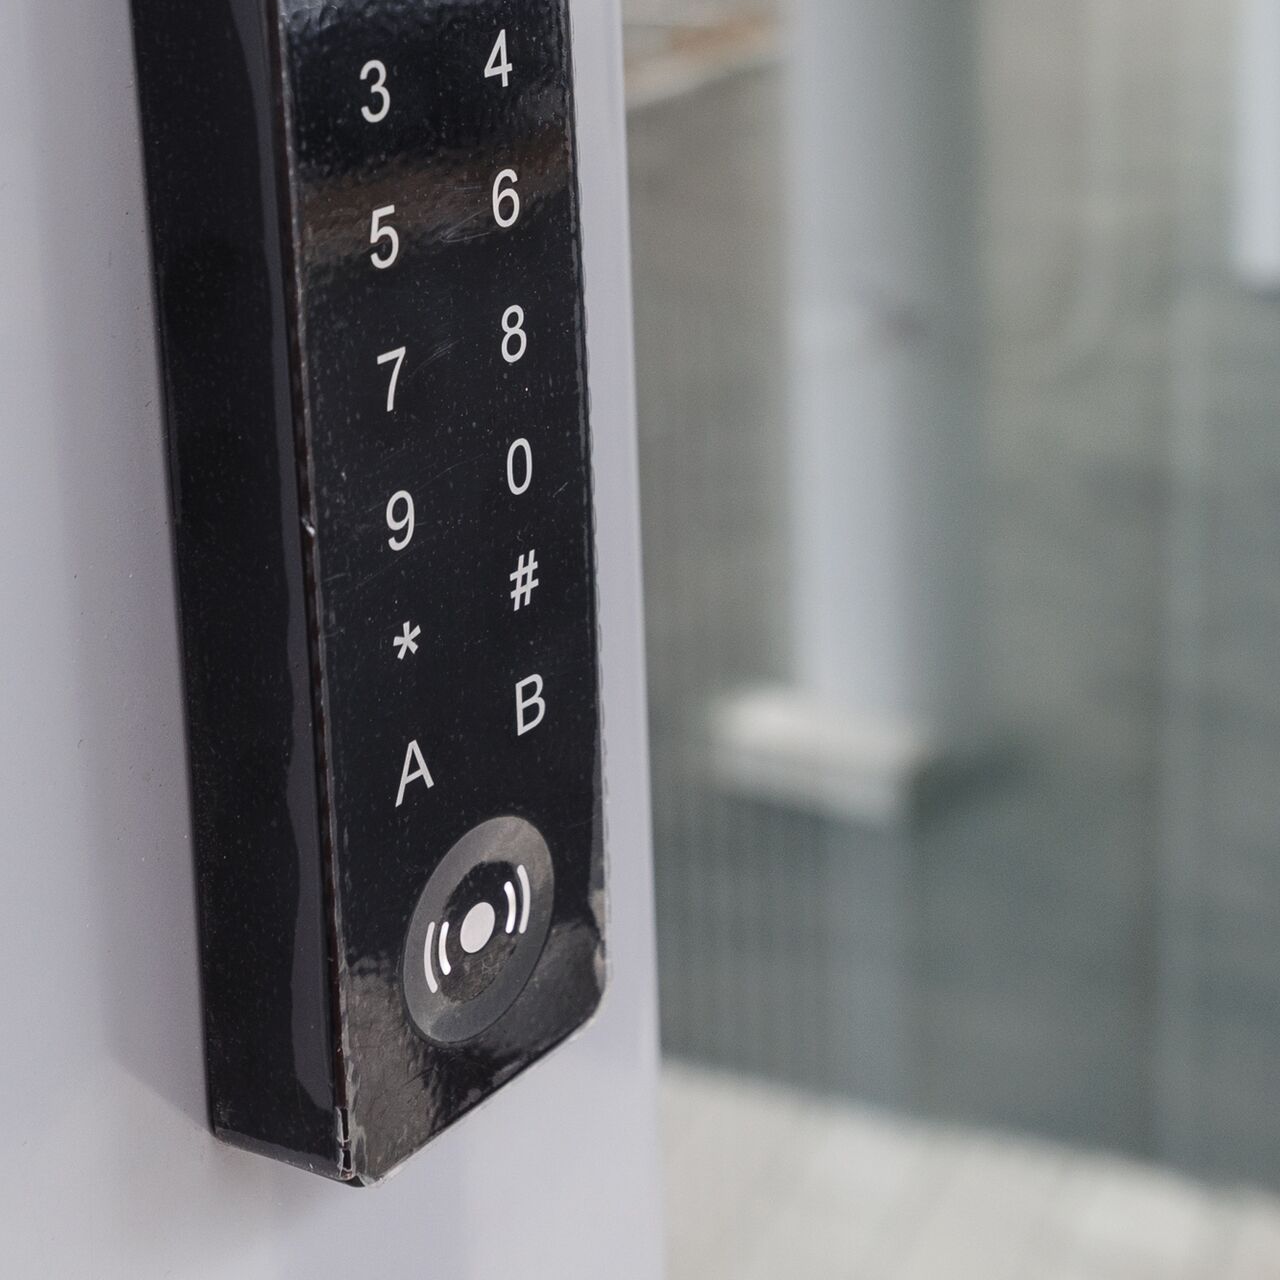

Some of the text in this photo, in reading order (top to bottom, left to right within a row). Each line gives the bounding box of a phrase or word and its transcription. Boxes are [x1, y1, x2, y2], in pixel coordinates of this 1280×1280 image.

[484, 29, 513, 87] 4
[360, 60, 390, 123] 3
[492, 168, 520, 228] 6
[370, 204, 399, 269] 5
[501, 304, 527, 363] 8
[377, 346, 406, 412] 7
[506, 437, 533, 495] 0
[386, 490, 415, 551] 9
[509, 549, 539, 611] #
[515, 673, 546, 736] B
[395, 740, 434, 807] A
